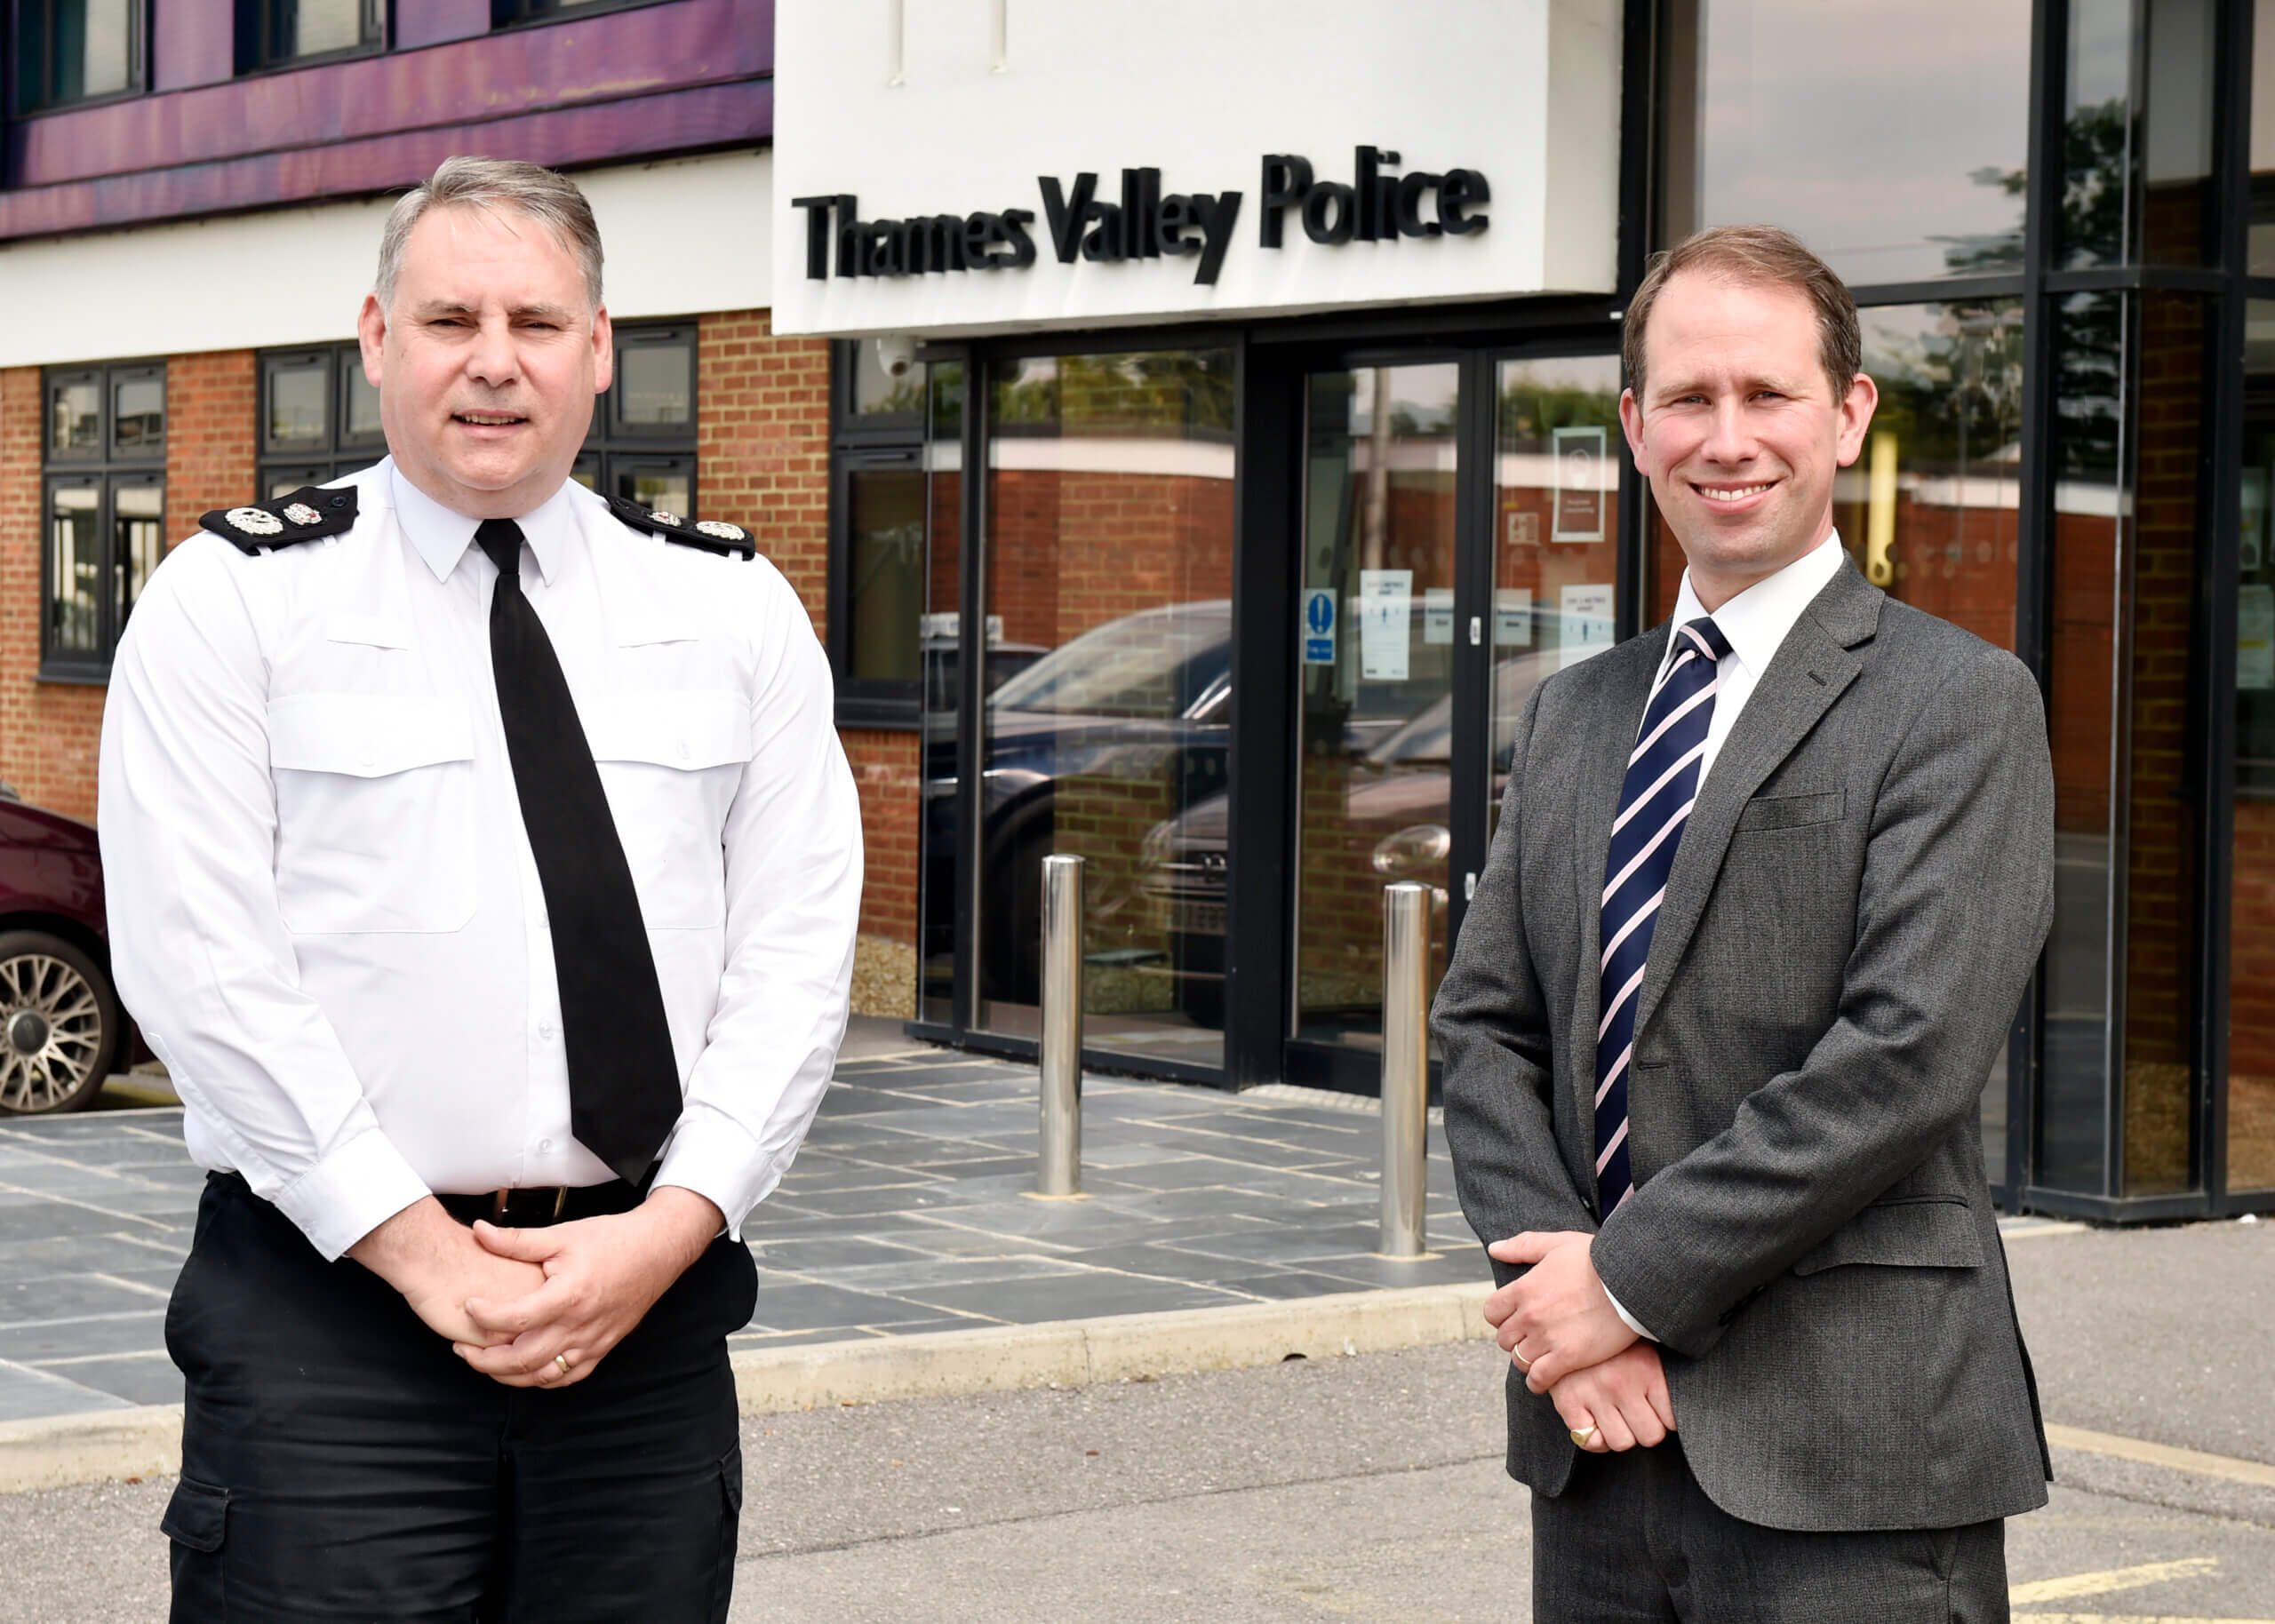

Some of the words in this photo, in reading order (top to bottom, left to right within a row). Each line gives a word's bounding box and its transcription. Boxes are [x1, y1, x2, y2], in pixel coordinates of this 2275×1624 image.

[793, 195, 1036, 280] Thames
[1039, 167, 1242, 285] Valley
[1260, 145, 1490, 250] Police
